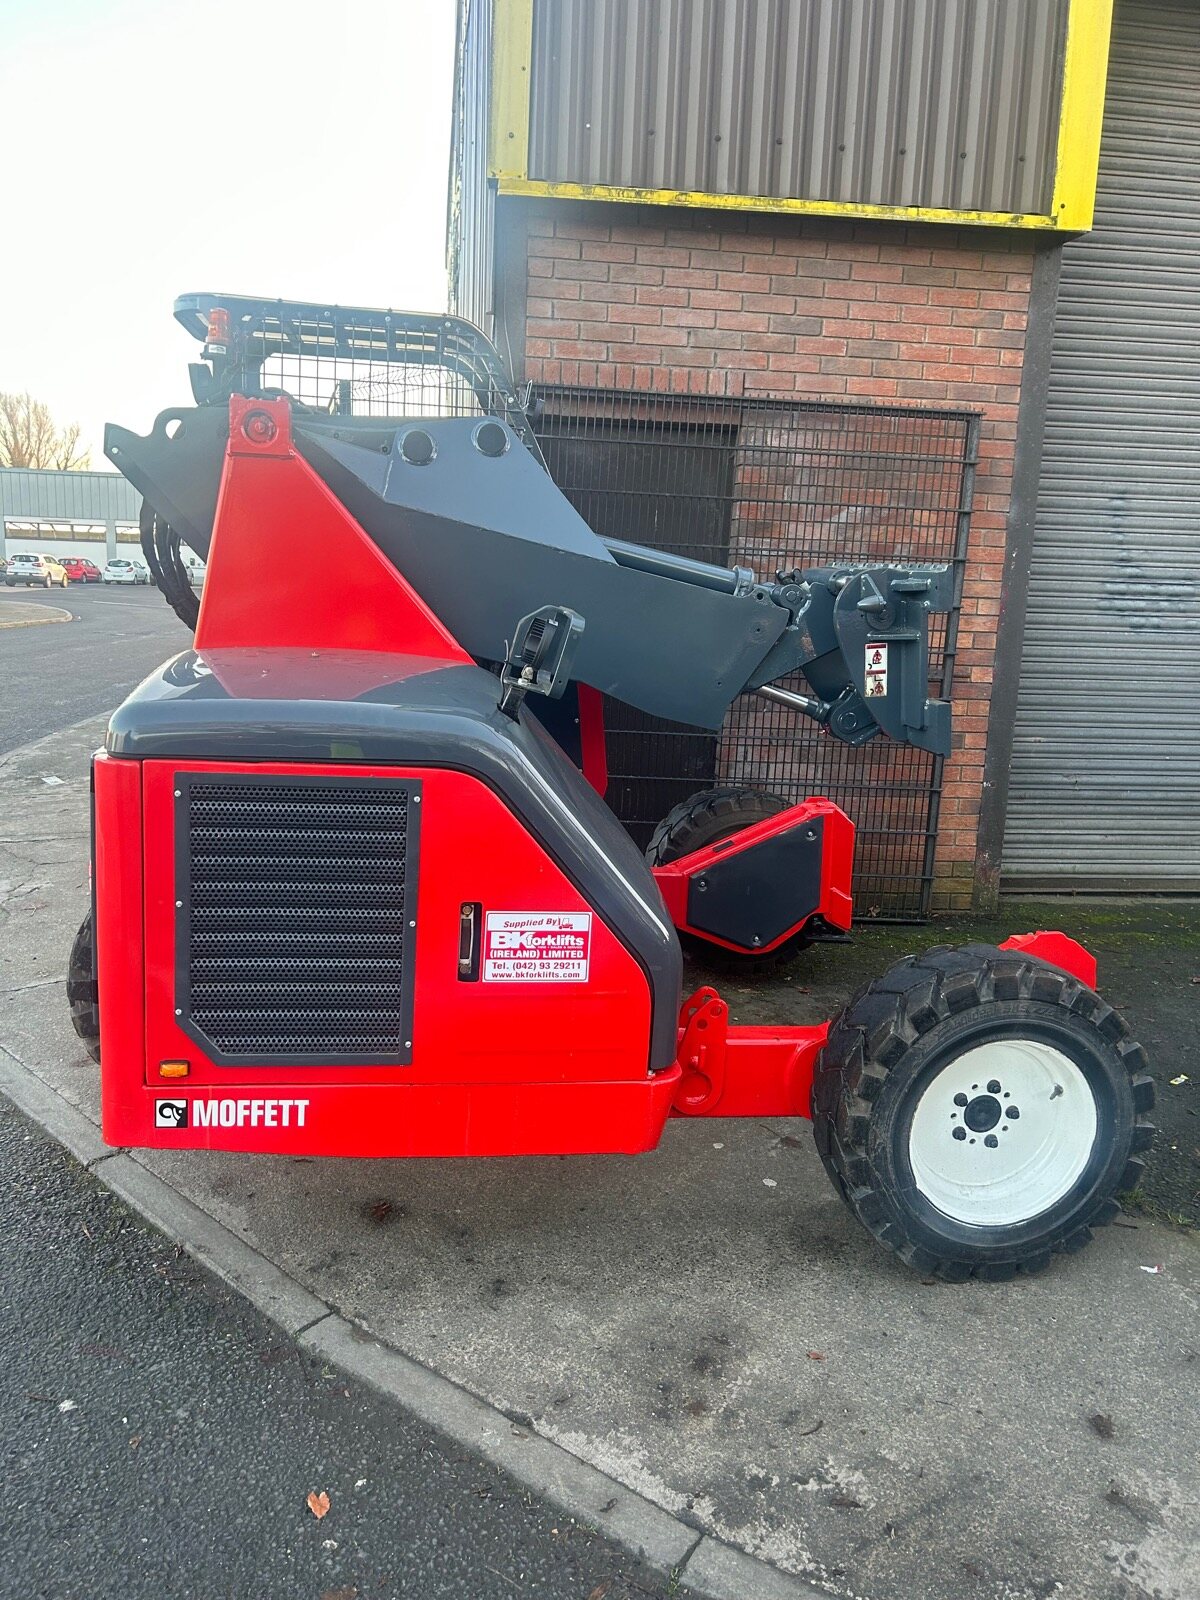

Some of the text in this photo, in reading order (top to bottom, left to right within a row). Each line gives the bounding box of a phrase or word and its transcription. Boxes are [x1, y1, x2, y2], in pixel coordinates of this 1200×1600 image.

[503, 918, 557, 929] Supplied By
[490, 950, 584, 959] (IRELAND) LIMITED
[492, 962, 581, 971] Tel. (042) 93 29211
[492, 971, 580, 979] www.bkforklifts.com
[193, 1099, 310, 1127] MOFFETT
